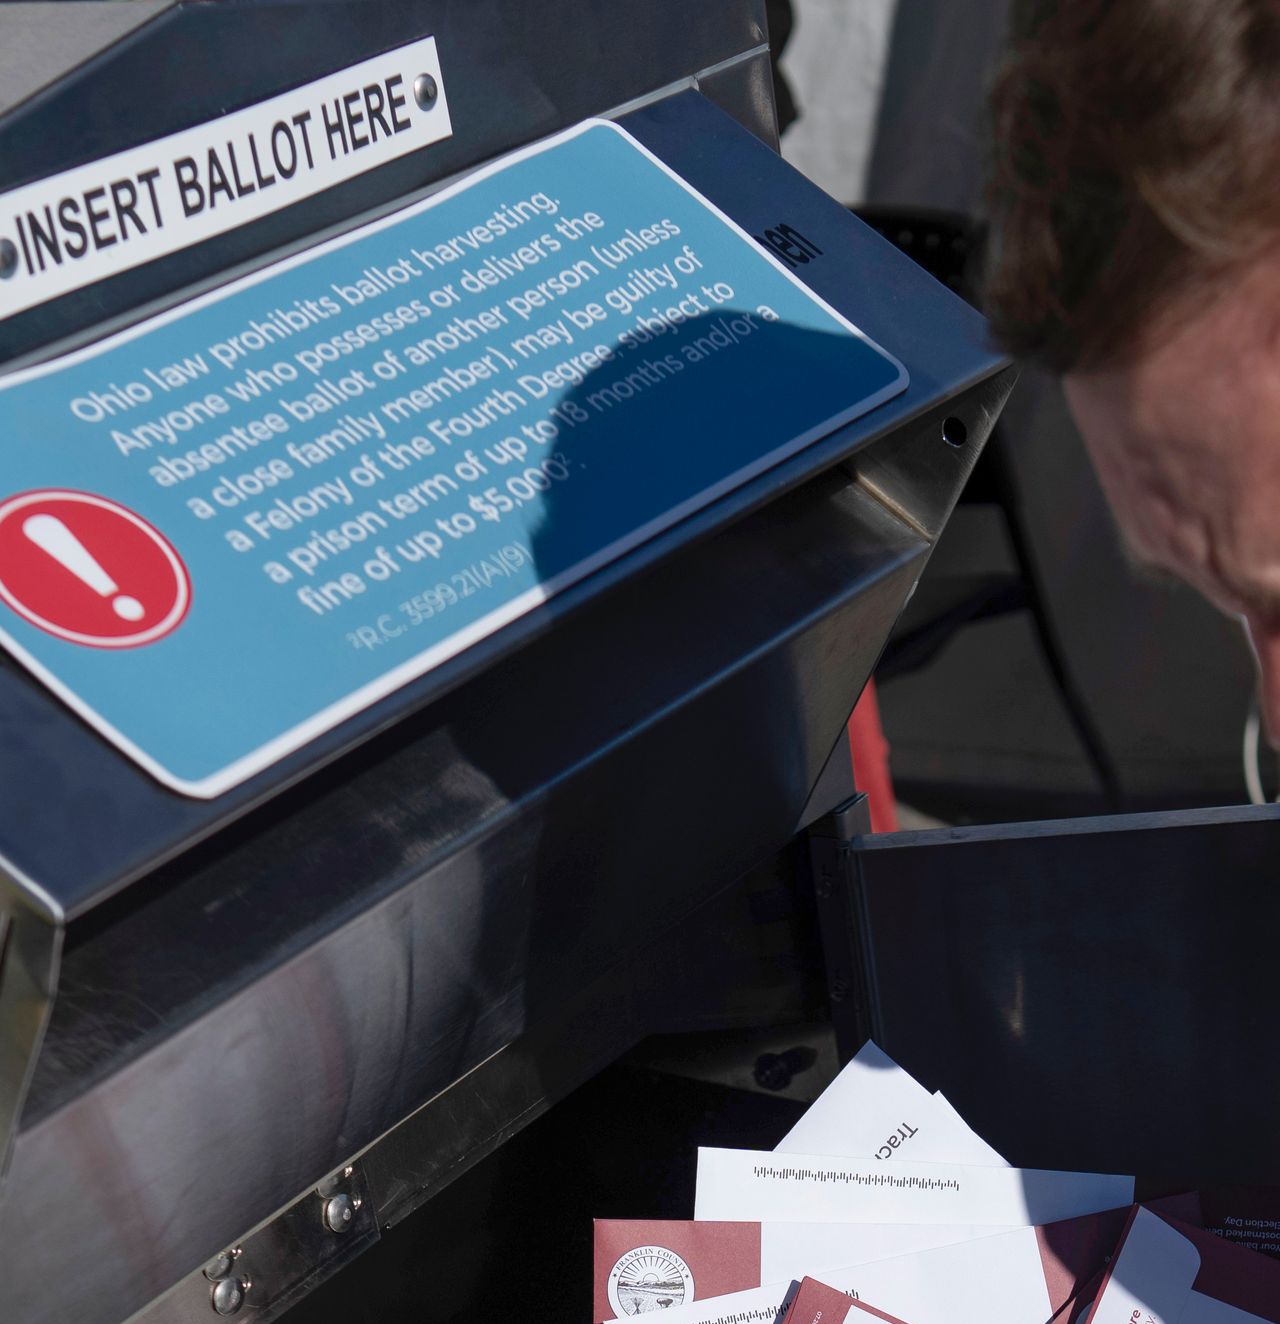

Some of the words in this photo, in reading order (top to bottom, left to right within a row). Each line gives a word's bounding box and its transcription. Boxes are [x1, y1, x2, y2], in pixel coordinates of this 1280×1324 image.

[14, 170, 165, 276] INSERT
[177, 112, 311, 220] BALLOT
[322, 73, 412, 161] HERE
[70, 382, 151, 422] Ohio
[143, 353, 208, 390] law
[209, 296, 340, 366] prohibits
[331, 258, 421, 305] ballot
[411, 193, 559, 268] harvesting.
[111, 394, 228, 454] Anyone
[225, 362, 297, 401] who
[296, 300, 430, 373] possesses
[428, 284, 460, 307] or
[460, 234, 560, 292] delivers
[554, 212, 604, 240] the
[149, 413, 287, 485] absentee
[279, 370, 375, 421] ballot
[372, 349, 406, 379] of
[404, 306, 507, 364] another
[506, 260, 598, 317] person
[591, 219, 680, 268] (unless
[186, 497, 216, 519] a
[212, 459, 293, 506] close
[286, 412, 385, 466] family
[381, 346, 516, 421] member),
[511, 320, 573, 357] may
[561, 303, 607, 329] be
[605, 264, 677, 314] guilty
[674, 245, 702, 273] of
[225, 530, 254, 551] a
[244, 477, 352, 538] Felony
[350, 453, 384, 486] of
[378, 436, 434, 469] the
[427, 389, 526, 443] Fourth
[517, 344, 623, 398] Degree,
[618, 293, 708, 345] subject
[700, 282, 734, 303] to
[263, 561, 292, 583] a
[288, 511, 386, 574] prison
[378, 474, 458, 518] term
[454, 449, 487, 480] of
[484, 436, 527, 464] up
[520, 419, 556, 444] to
[547, 400, 588, 426] 18
[586, 355, 683, 410] months
[681, 314, 758, 361] and/or
[756, 304, 779, 319] a
[297, 573, 365, 613] fine
[364, 546, 399, 579] of
[396, 531, 442, 561] up
[435, 512, 476, 538] to
[615, 1247, 654, 1271] FRANKLIN
[657, 1248, 687, 1272] COUNTY
